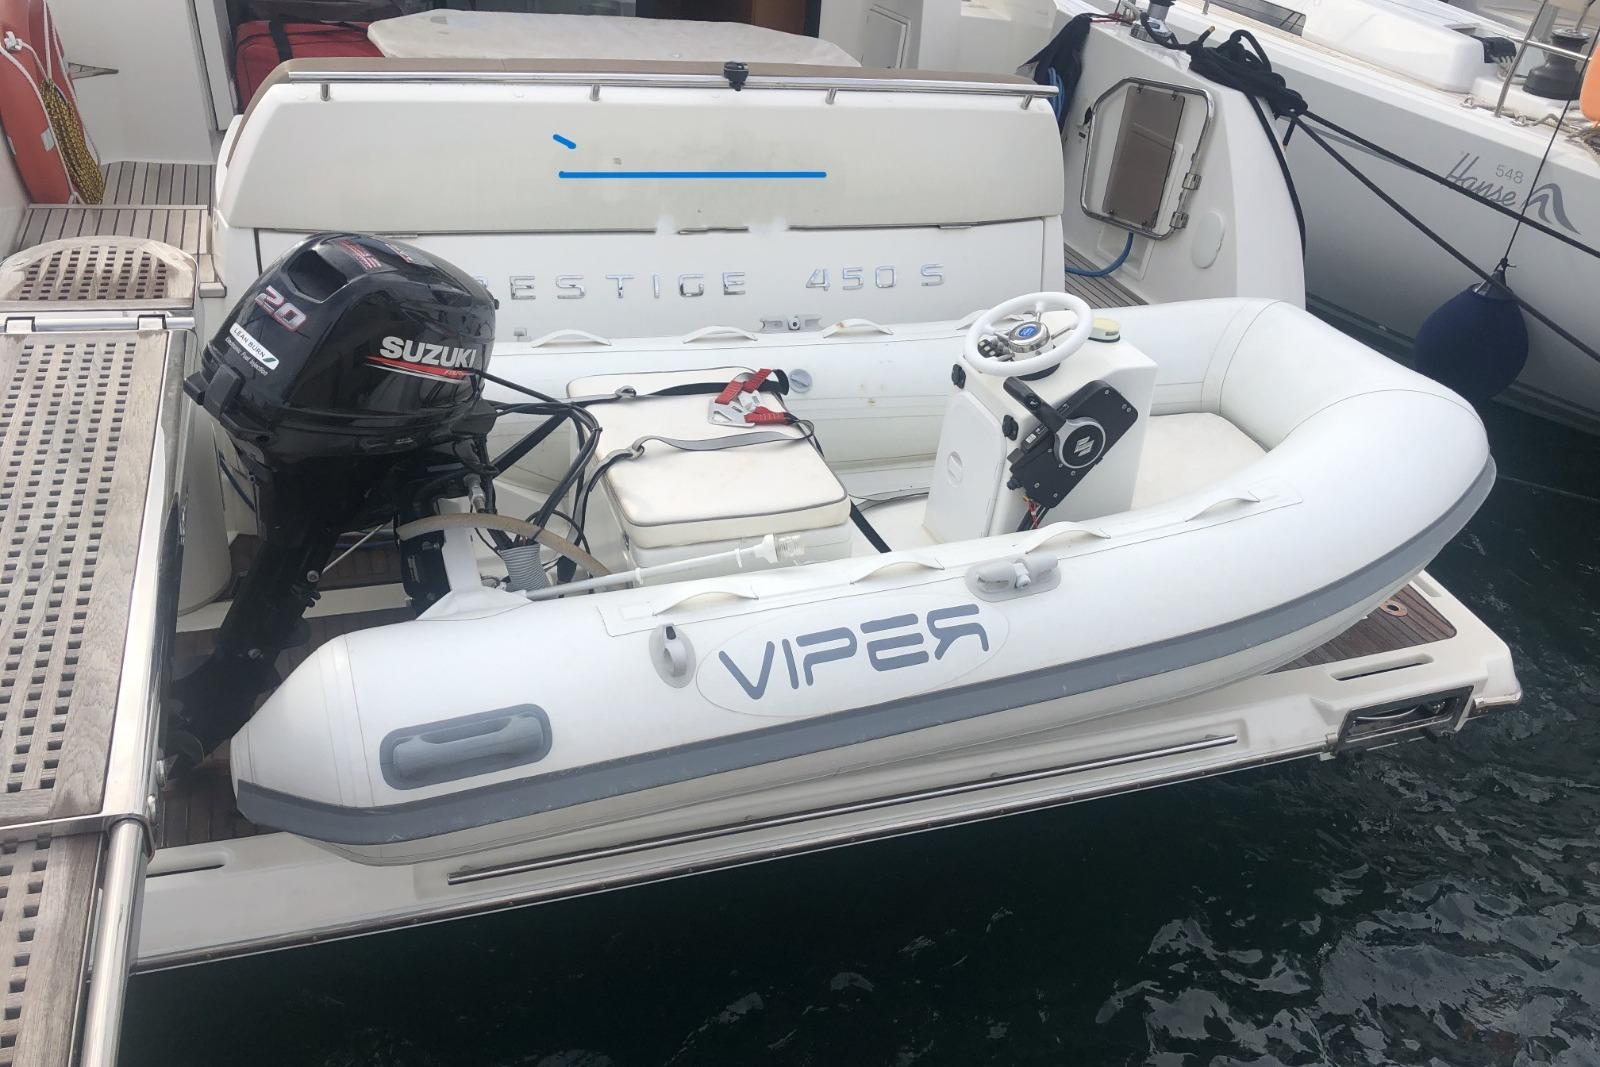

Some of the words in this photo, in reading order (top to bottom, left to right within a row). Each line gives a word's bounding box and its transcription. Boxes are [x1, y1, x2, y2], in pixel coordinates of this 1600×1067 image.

[1445, 153, 1516, 206] Hanse
[1495, 164, 1524, 184] 548
[473, 271, 746, 300] ESTIGE
[805, 265, 897, 292] 450
[920, 263, 945, 287] S
[254, 284, 307, 333] 20
[233, 327, 249, 344] LEAN
[247, 340, 266, 358] BURN
[379, 335, 477, 368] SUZUKI
[718, 604, 989, 700] VIPER
